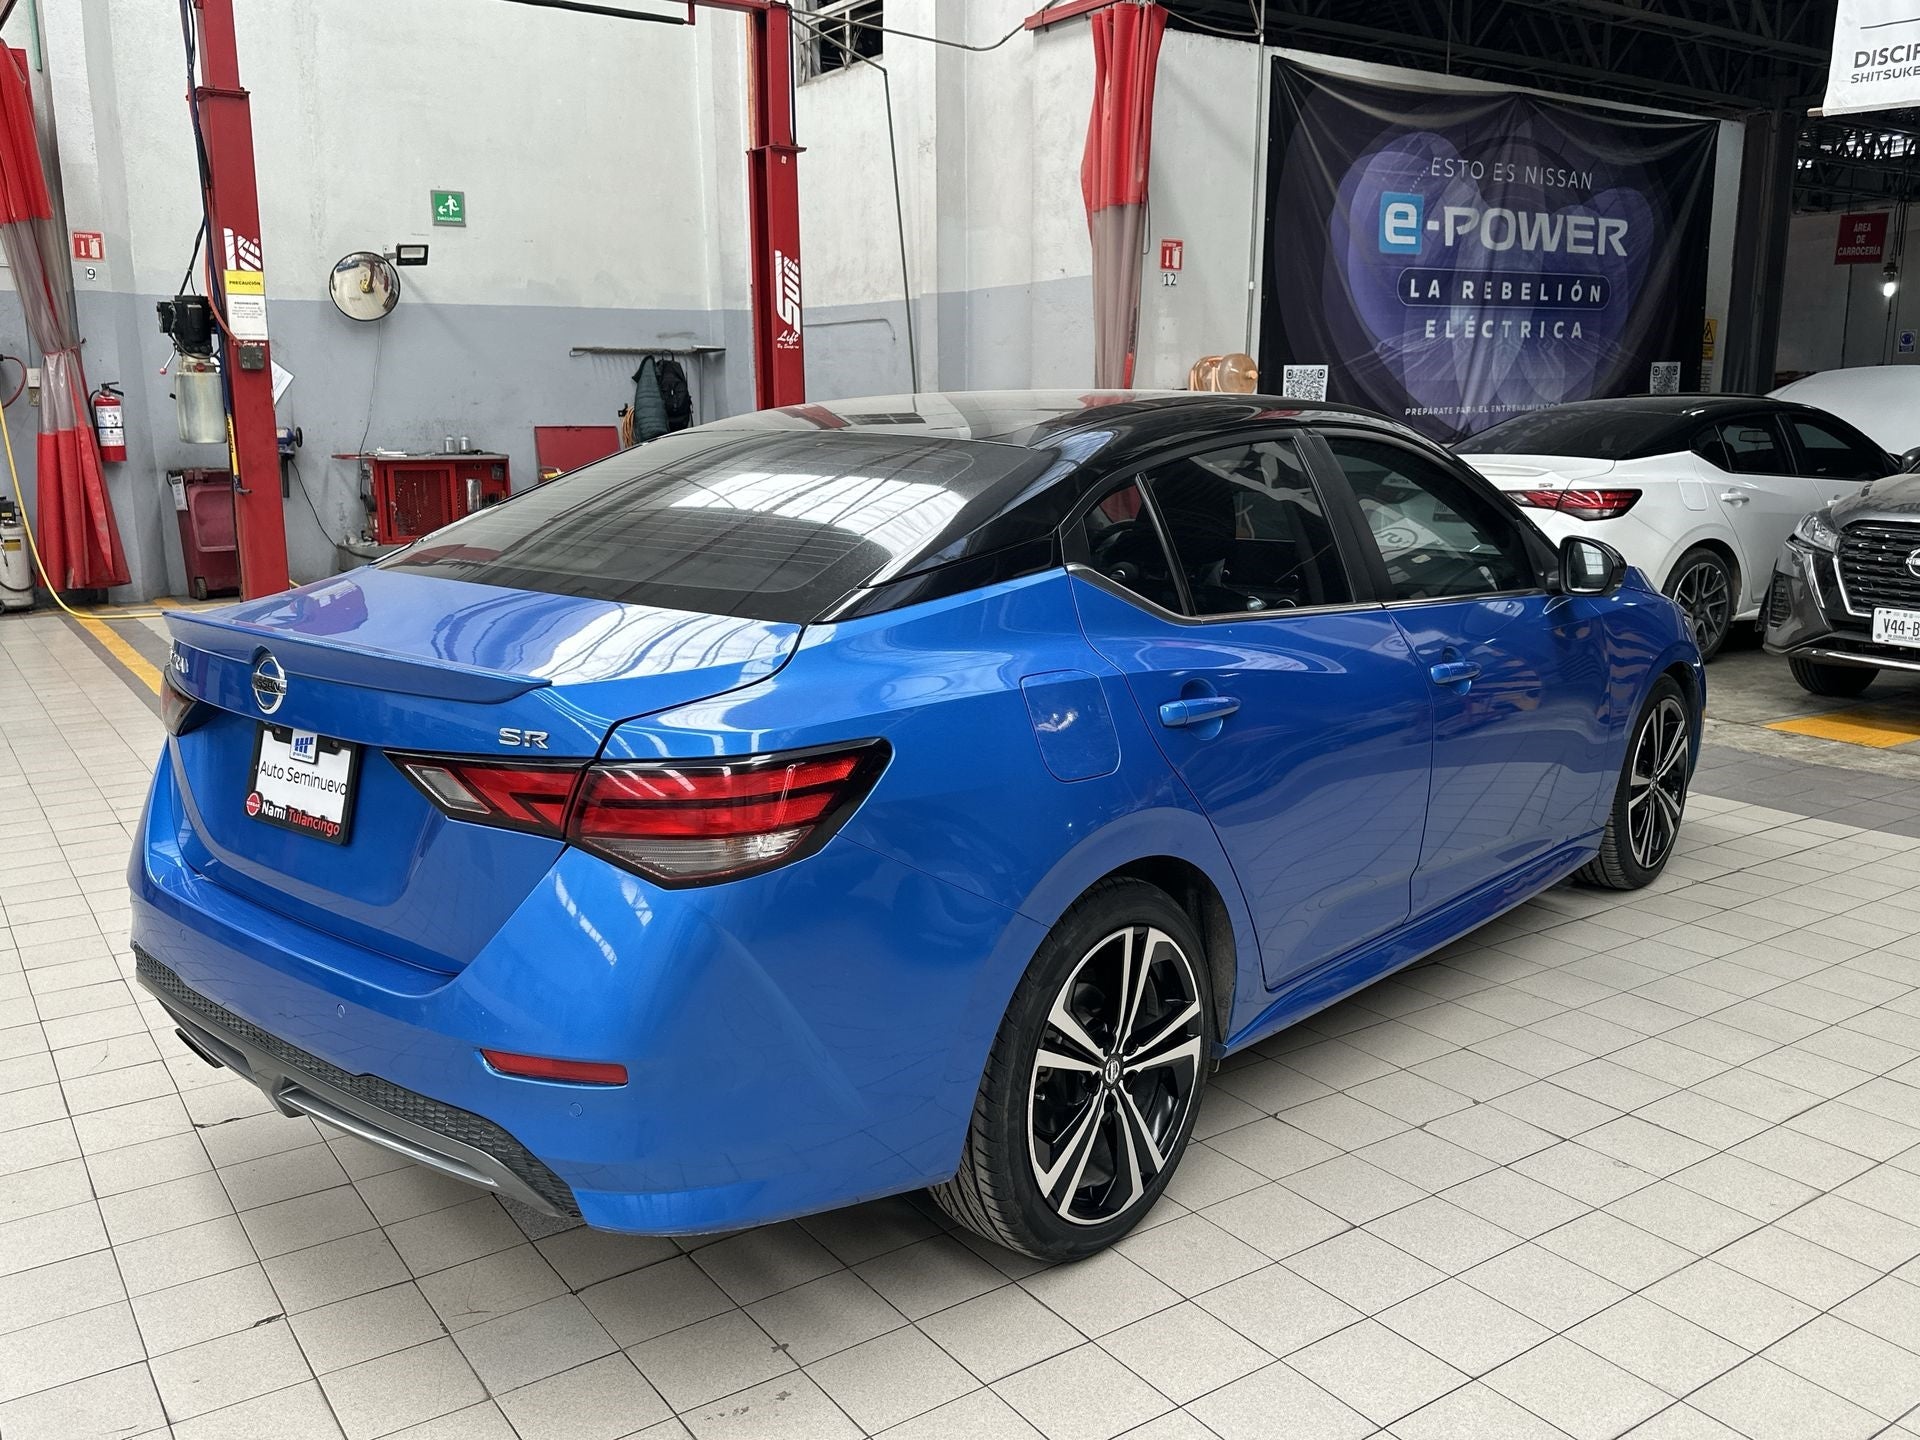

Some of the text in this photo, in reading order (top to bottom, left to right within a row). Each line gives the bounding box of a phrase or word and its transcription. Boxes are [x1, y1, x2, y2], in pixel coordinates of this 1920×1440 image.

[1850, 65, 1920, 84] SHITSUKE
[1430, 157, 1593, 190] ESTO ES NISSAN
[1384, 202, 1628, 257] e-POWER
[1853, 221, 1872, 232] ÁREA
[1856, 234, 1866, 244] DE
[1837, 244, 1881, 256] CARROCERÍA
[87, 268, 96, 280] 9
[1163, 273, 1177, 286] 12
[1409, 278, 1600, 302] LA REBELIÓN
[776, 329, 799, 345] Lift
[1425, 316, 1582, 339] ELÉCTRICA
[1404, 405, 1453, 416] PREPÁRATE
[1478, 405, 1489, 413] EL
[498, 727, 549, 750] SR
[259, 760, 347, 796] Auto Seminuevo
[261, 801, 340, 837] Nami Tulancingo
